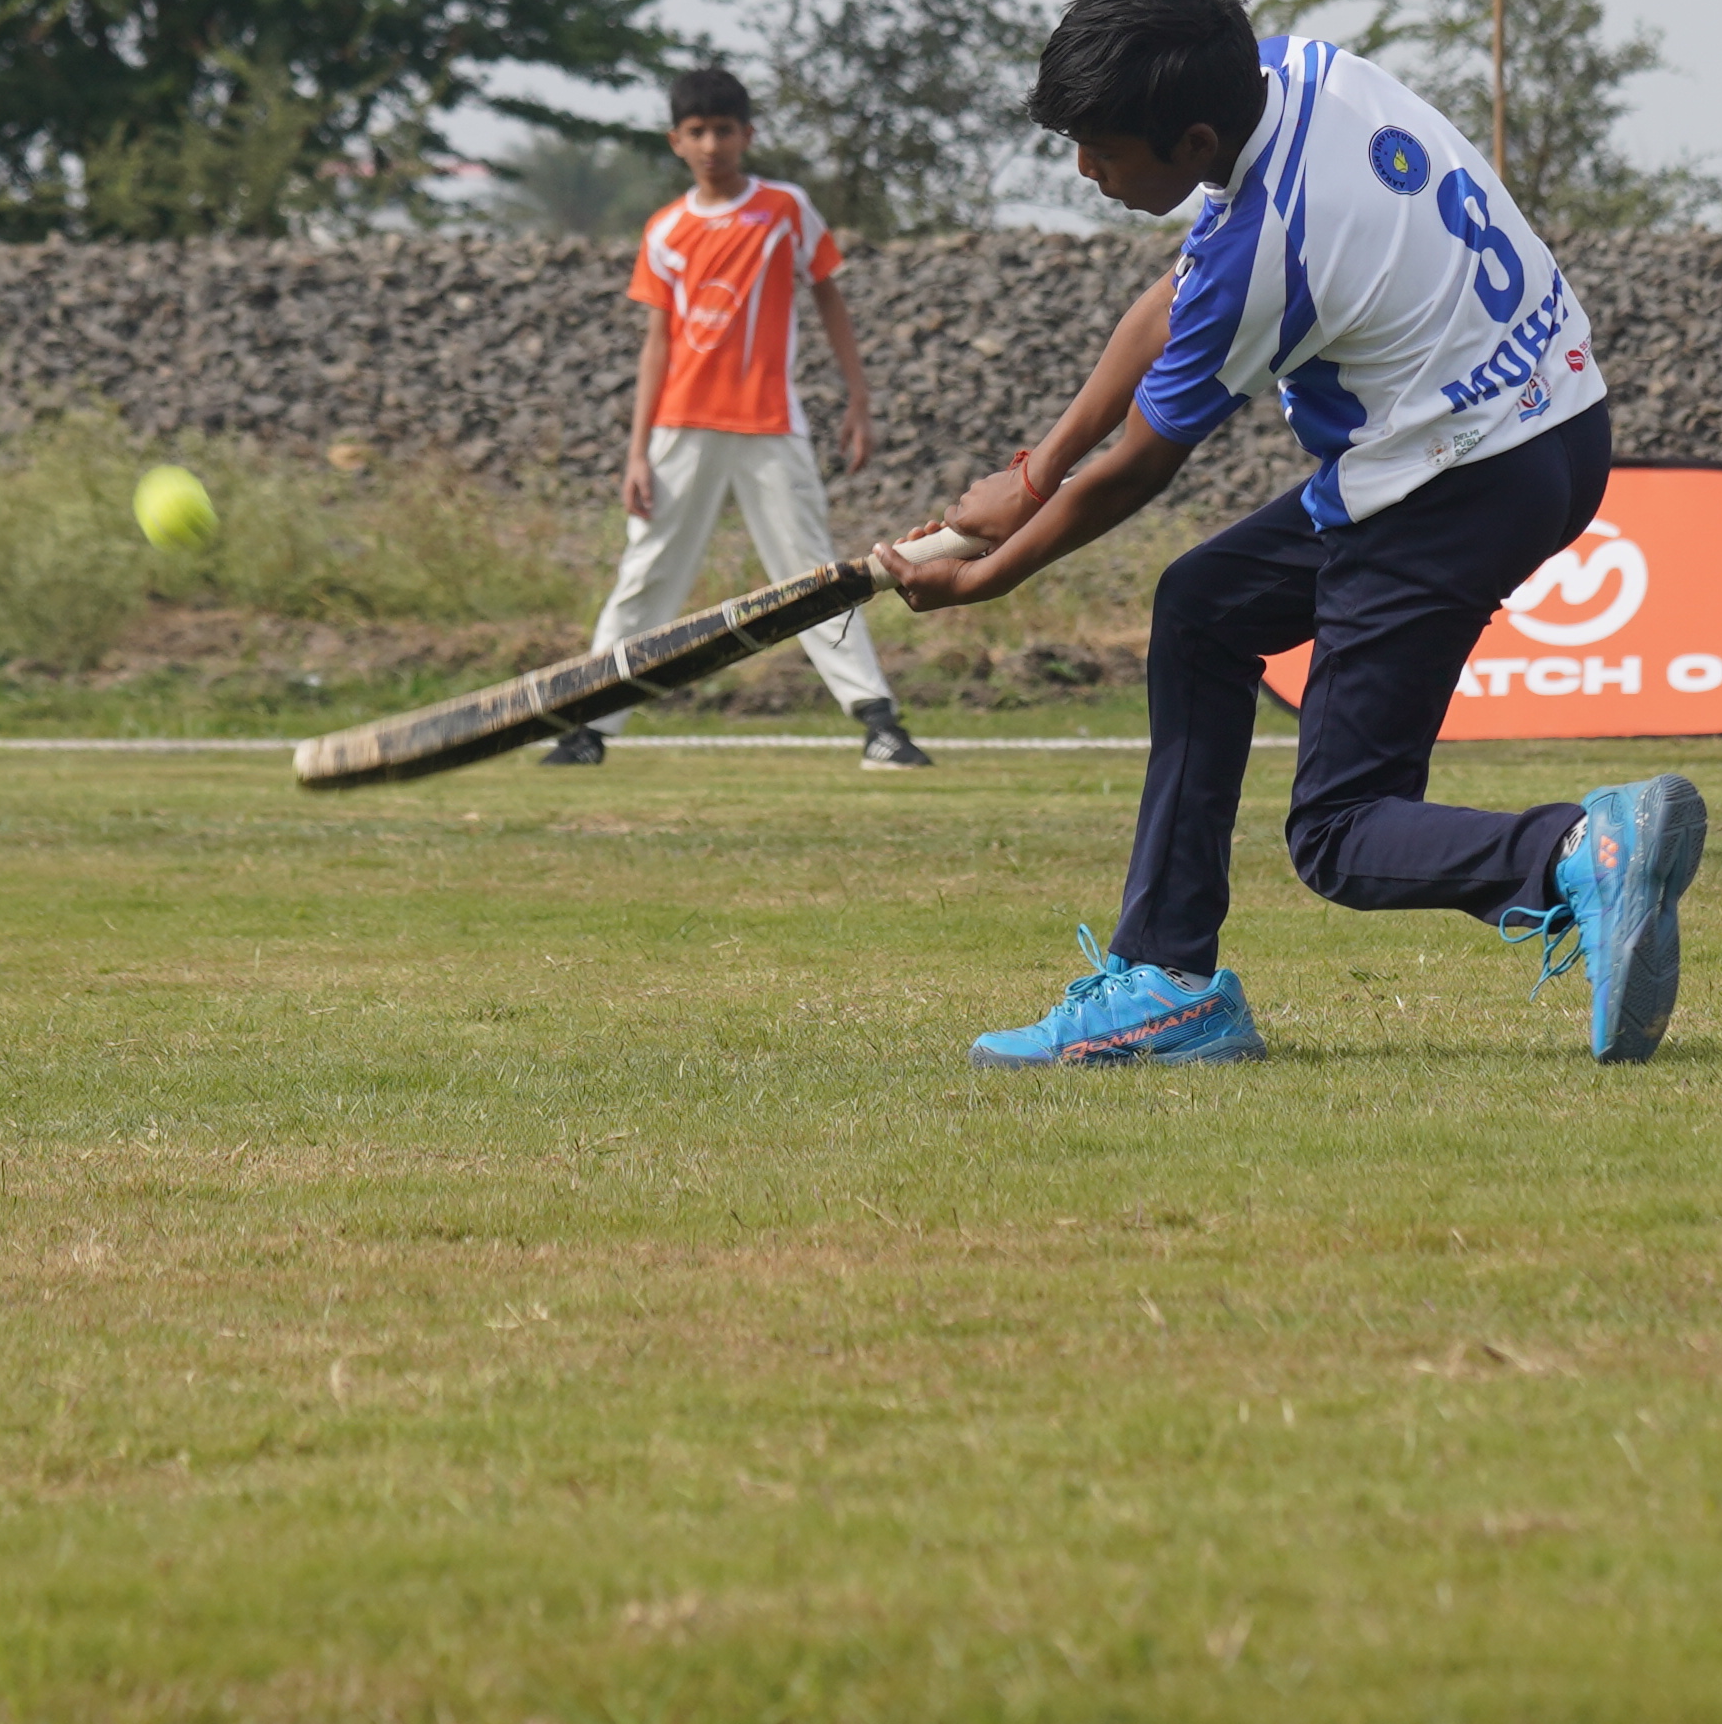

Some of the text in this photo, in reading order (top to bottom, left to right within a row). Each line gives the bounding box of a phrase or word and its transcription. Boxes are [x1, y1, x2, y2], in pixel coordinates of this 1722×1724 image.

[1437, 167, 1525, 323] 8
[1453, 429, 1480, 443] DELHI
[1454, 656, 1642, 697] ATCH
